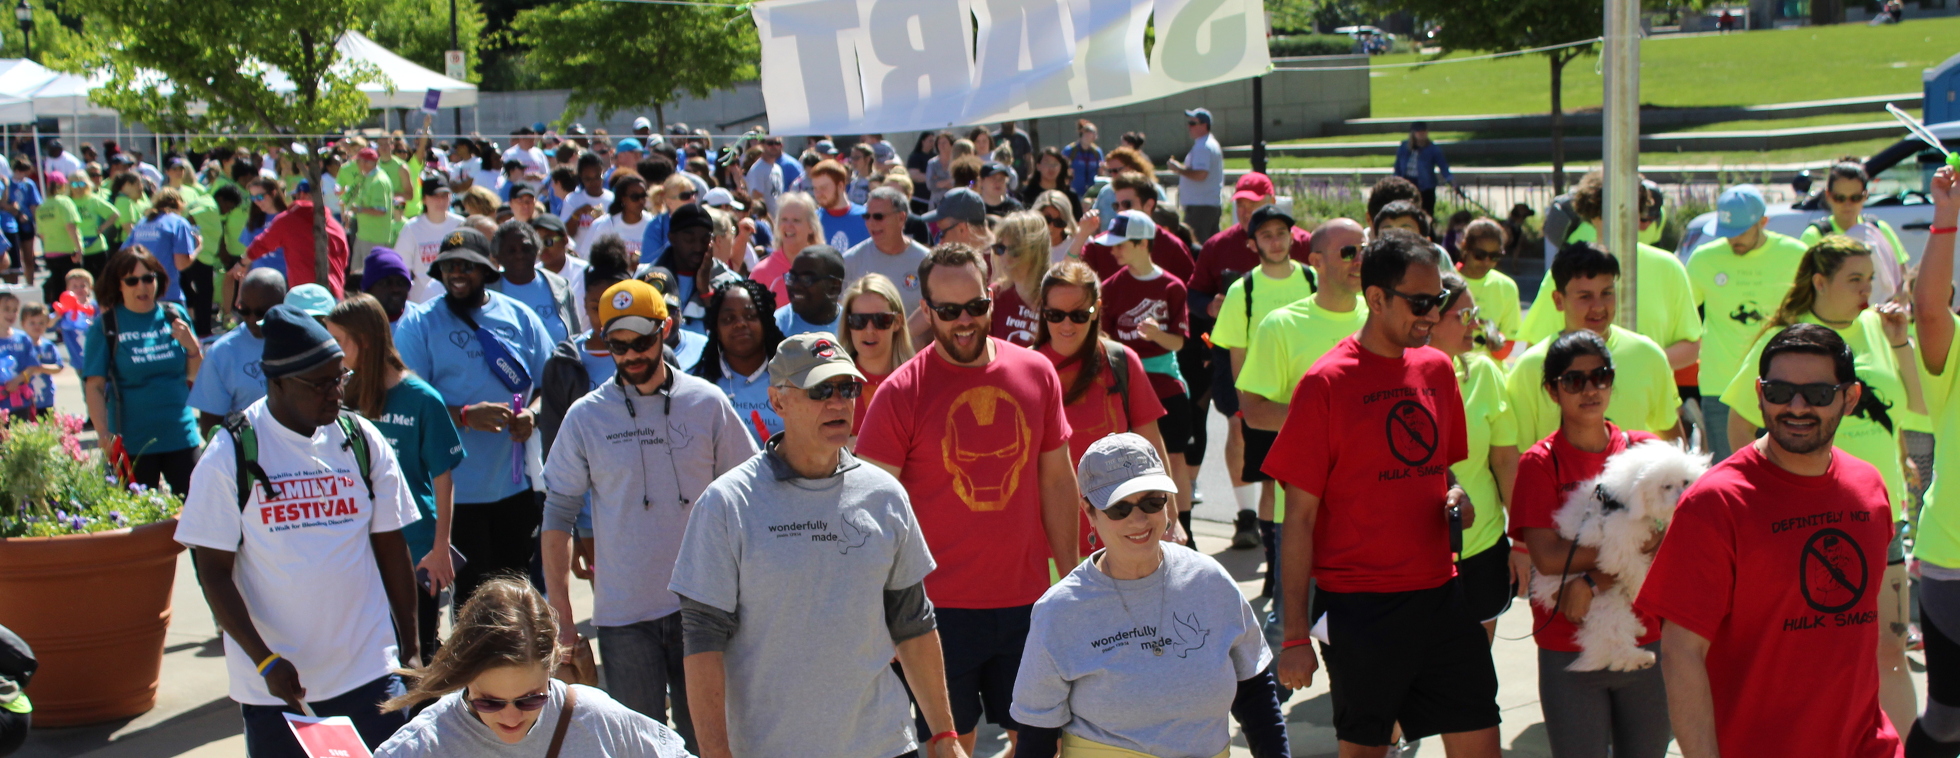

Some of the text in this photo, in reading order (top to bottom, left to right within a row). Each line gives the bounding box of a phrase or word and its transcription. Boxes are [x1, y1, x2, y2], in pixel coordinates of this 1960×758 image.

[1006, 315, 1027, 329] Iron
[131, 354, 147, 364] We
[495, 357, 521, 385] GRIFOLS
[1363, 387, 1418, 404] DEFINITELY
[735, 401, 766, 410] HEMO
[392, 413, 415, 427] Me!
[605, 427, 656, 440] wonderfully
[640, 437, 664, 445] made
[1378, 468, 1411, 481] HULK
[259, 496, 359, 525] FESTIVAL
[274, 524, 290, 532] Walk
[768, 520, 828, 532] wonderfully
[1771, 511, 1871, 533] DEFINITELY NOT
[811, 532, 838, 542] made
[1783, 615, 1826, 631] HULK
[1091, 625, 1157, 648] wonderfully
[1140, 636, 1173, 651] made
